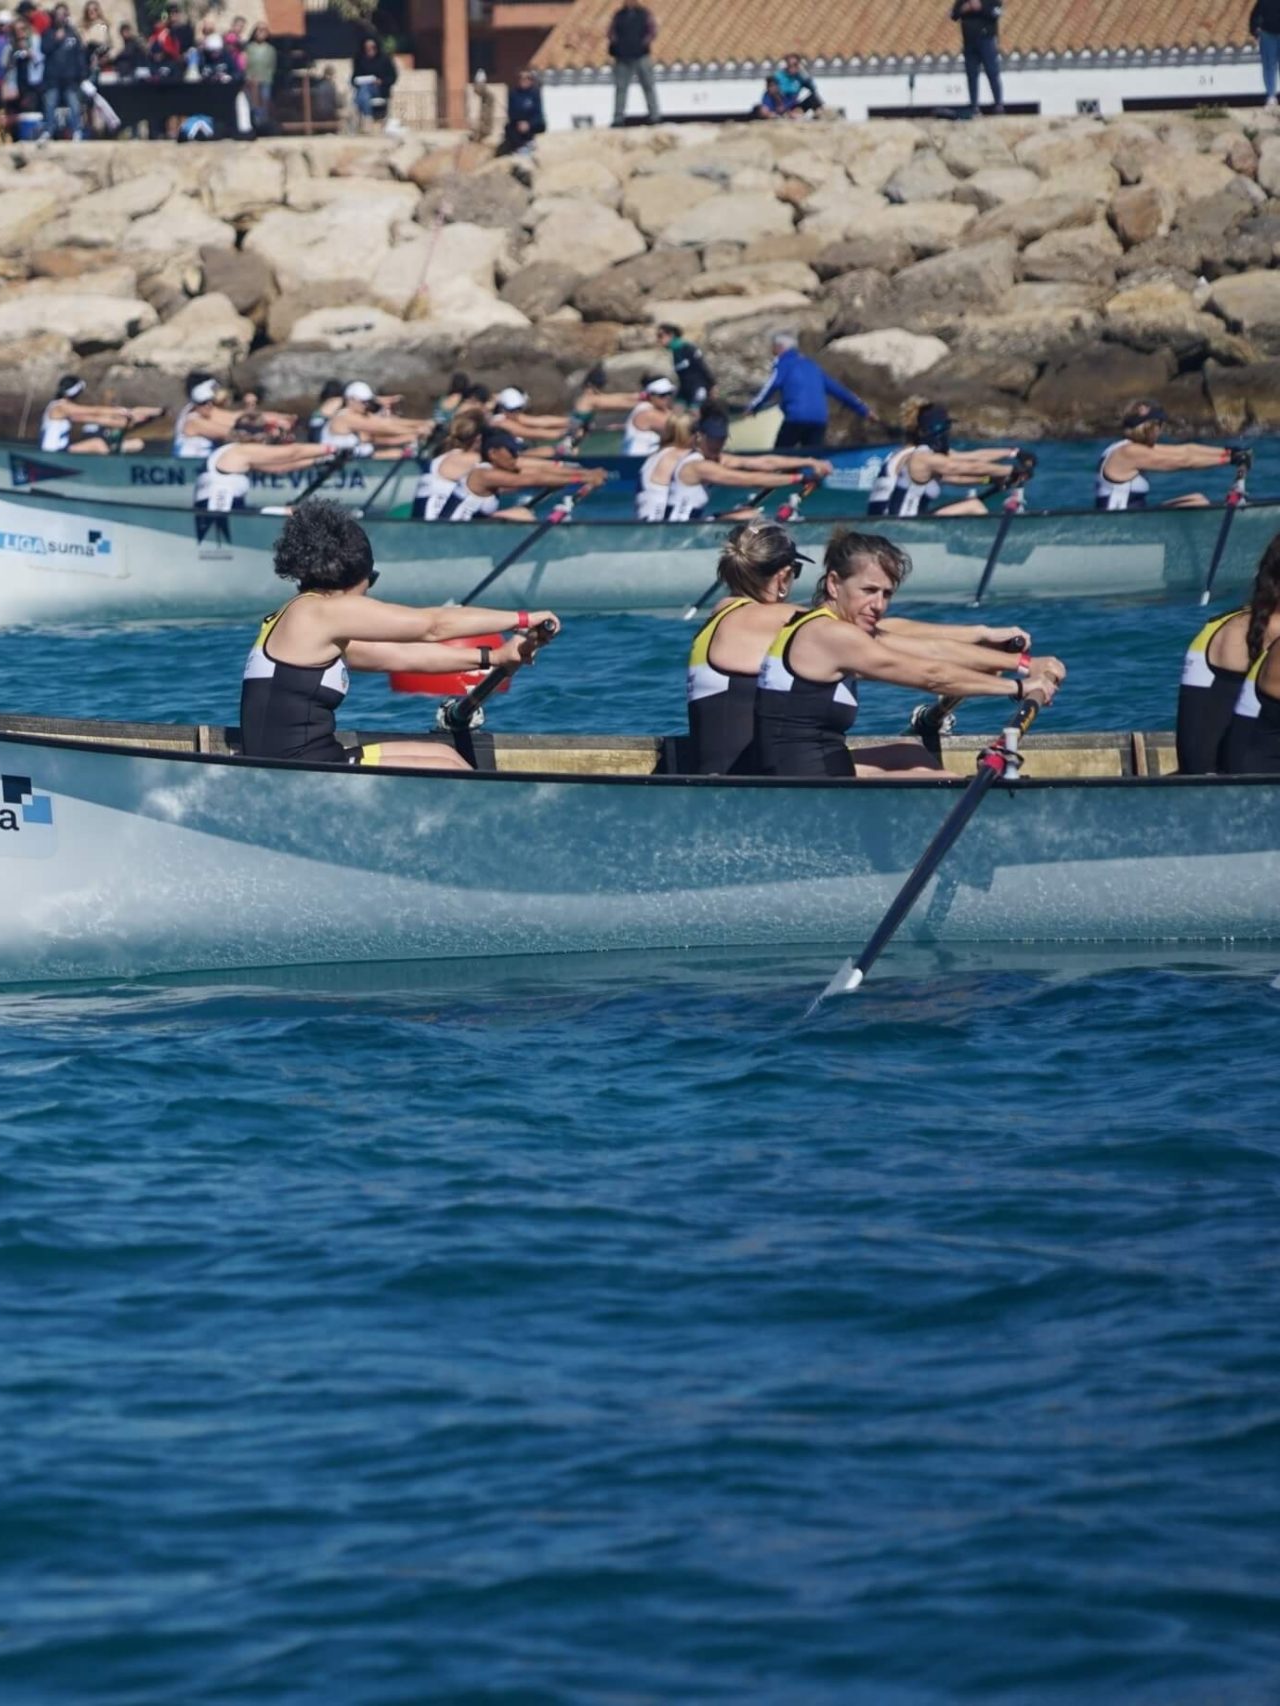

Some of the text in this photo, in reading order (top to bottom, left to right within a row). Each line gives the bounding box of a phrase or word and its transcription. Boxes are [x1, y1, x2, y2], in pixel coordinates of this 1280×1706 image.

[131, 464, 186, 486] RCN
[3, 533, 95, 557] LIGA suma
